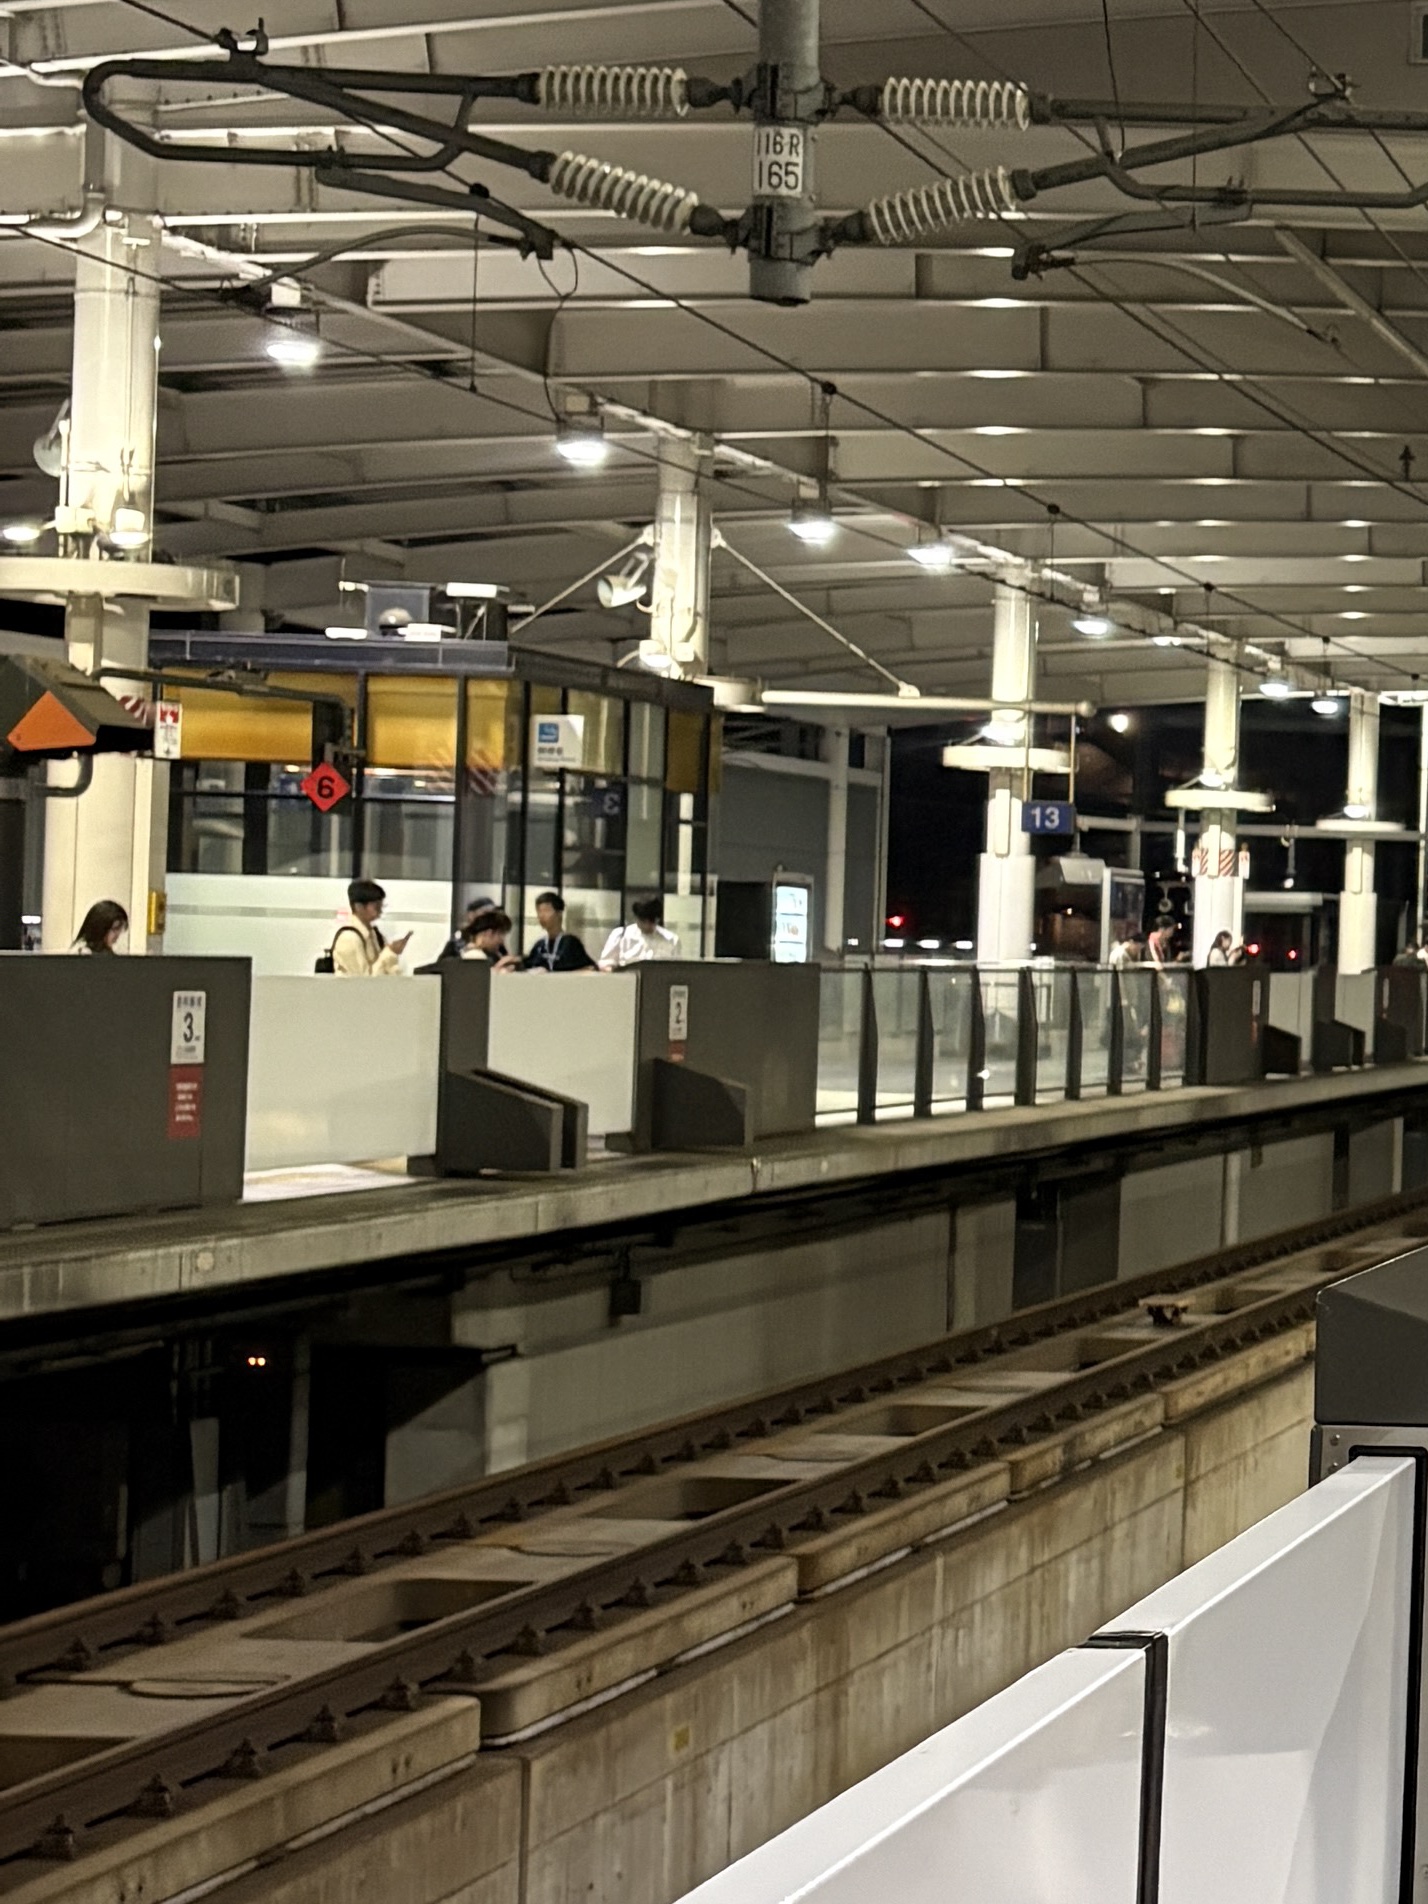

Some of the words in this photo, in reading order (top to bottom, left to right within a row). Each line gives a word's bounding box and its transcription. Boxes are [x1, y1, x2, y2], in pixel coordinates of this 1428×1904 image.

[758, 160, 799, 190] 165
[317, 776, 335, 799] 6
[1031, 806, 1060, 829] 13
[183, 1012, 194, 1043] 3
